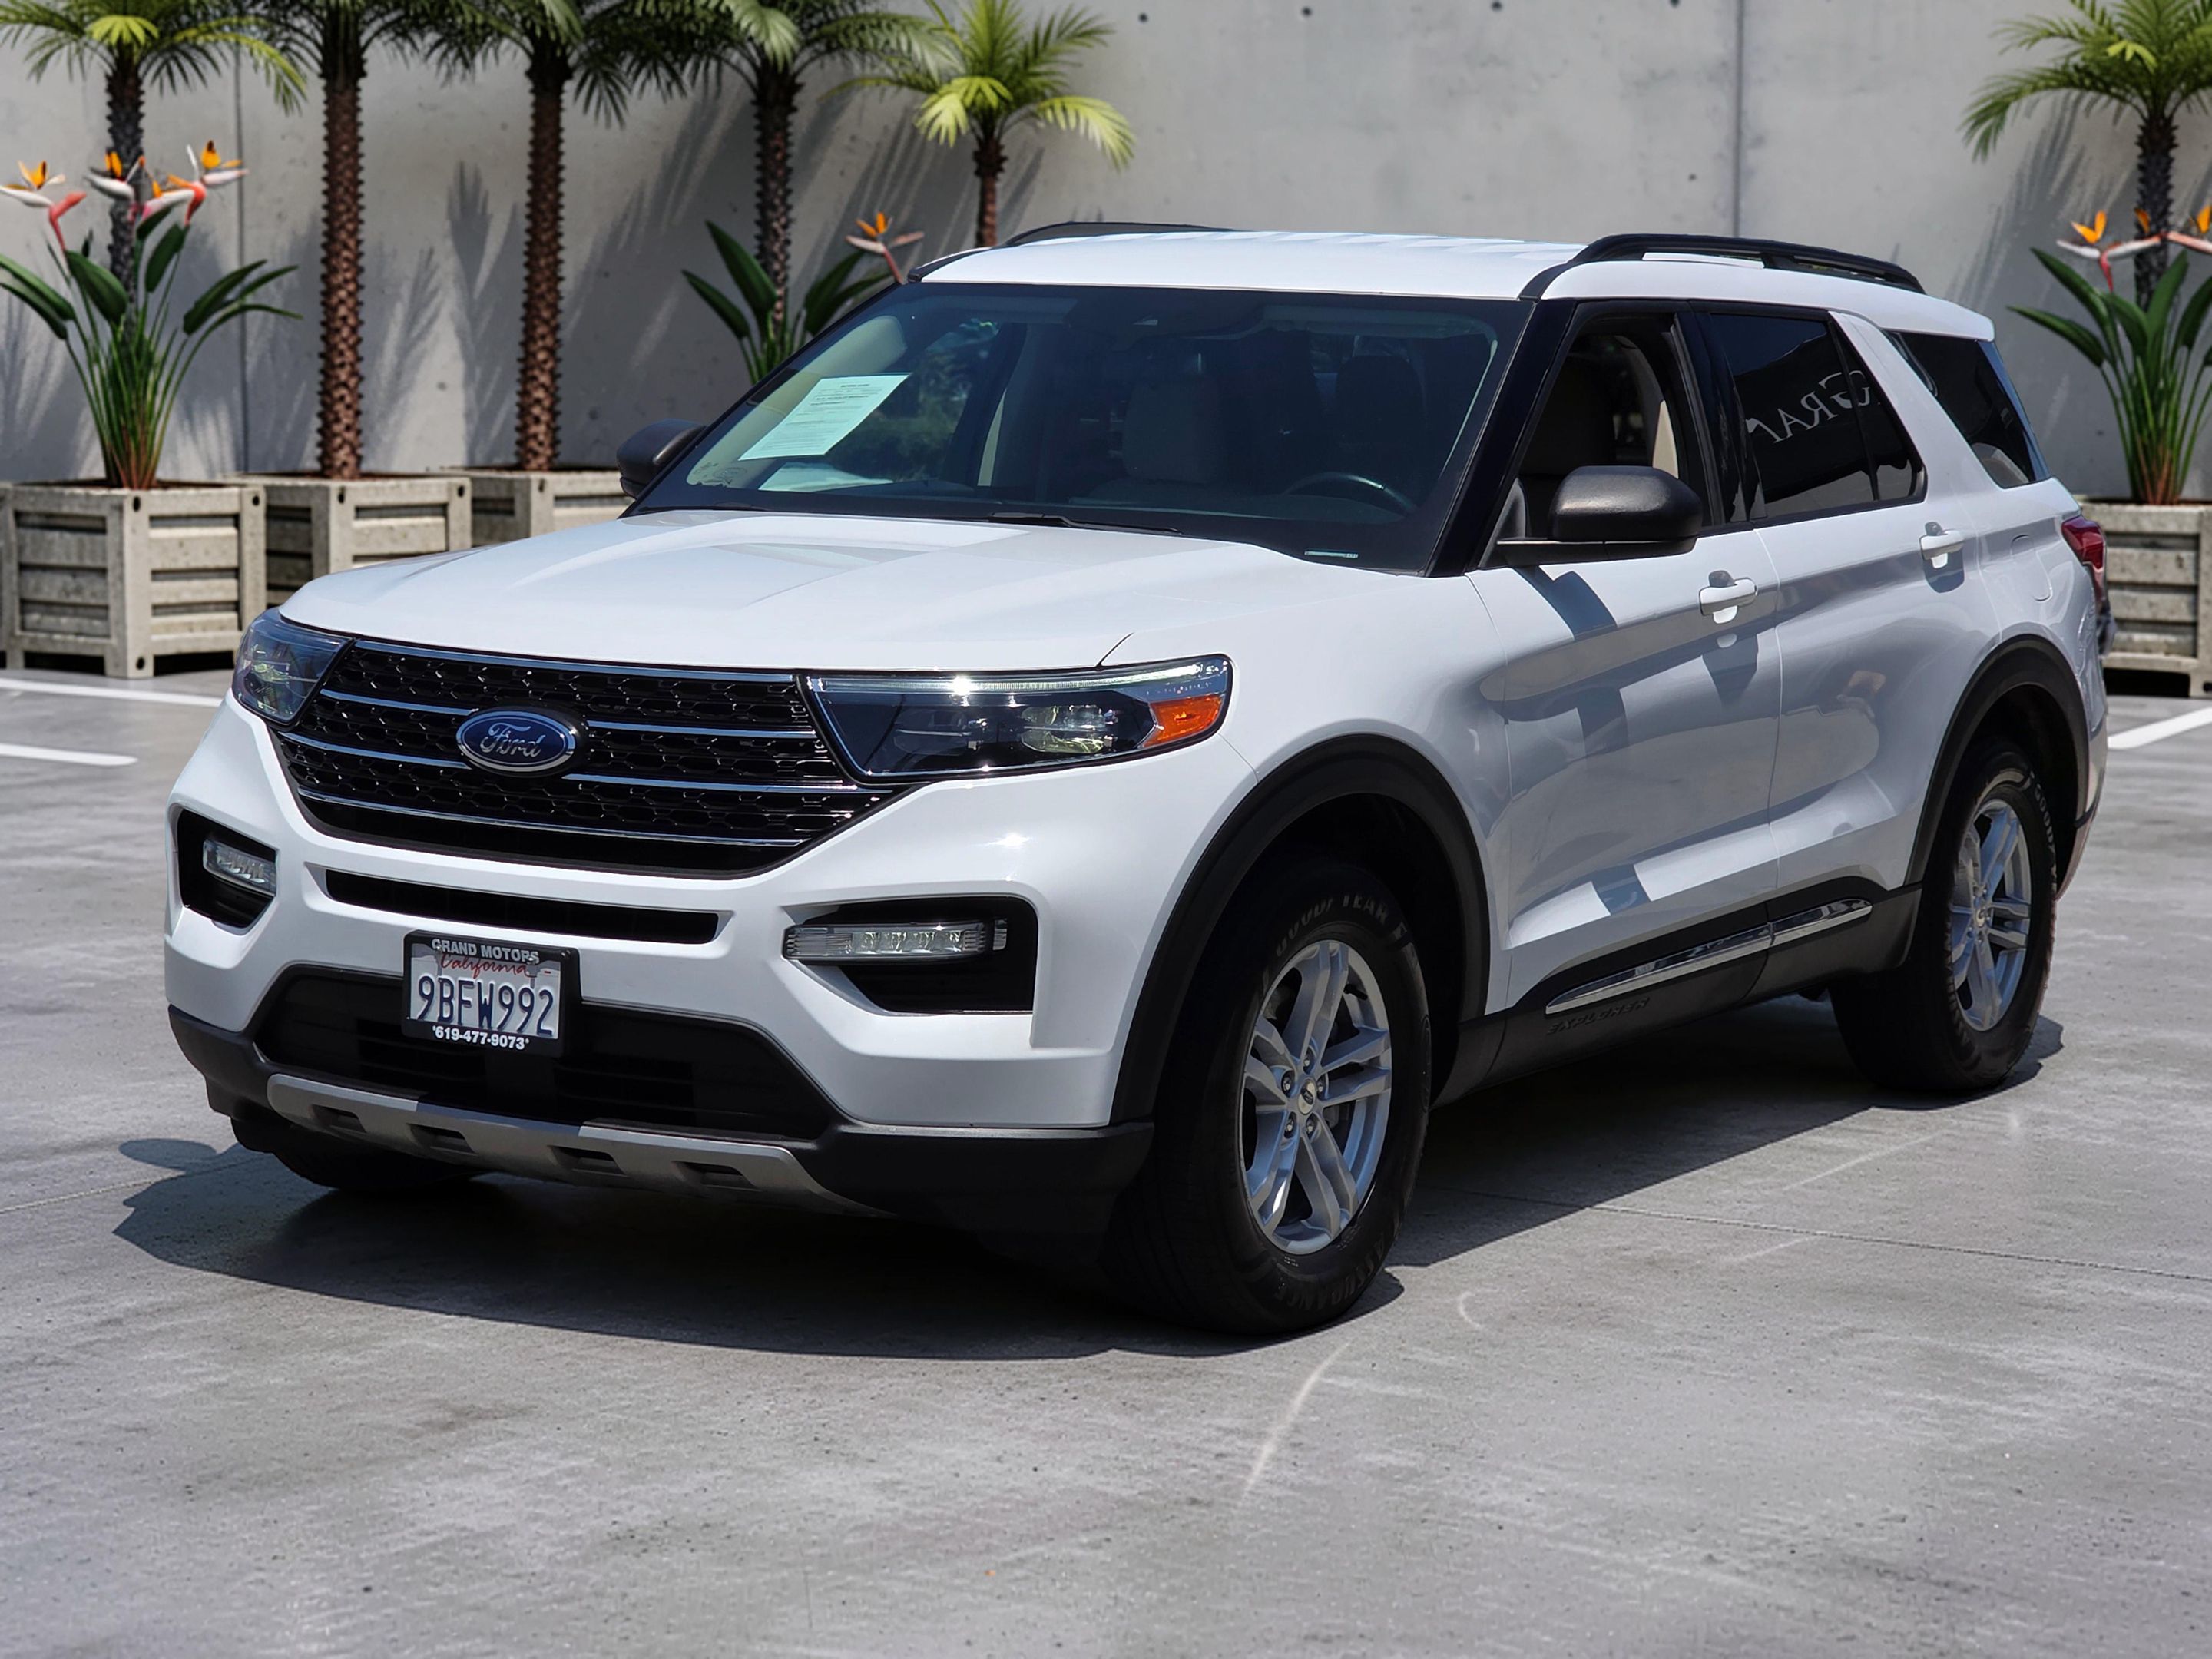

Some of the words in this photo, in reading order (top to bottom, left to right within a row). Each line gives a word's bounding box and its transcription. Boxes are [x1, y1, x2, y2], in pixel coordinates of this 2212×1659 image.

[480, 722, 546, 758] Ford
[432, 939, 478, 956] GRAND
[481, 945, 539, 965] MOTORS
[440, 954, 538, 979] California
[417, 975, 554, 1037] 9BFW992
